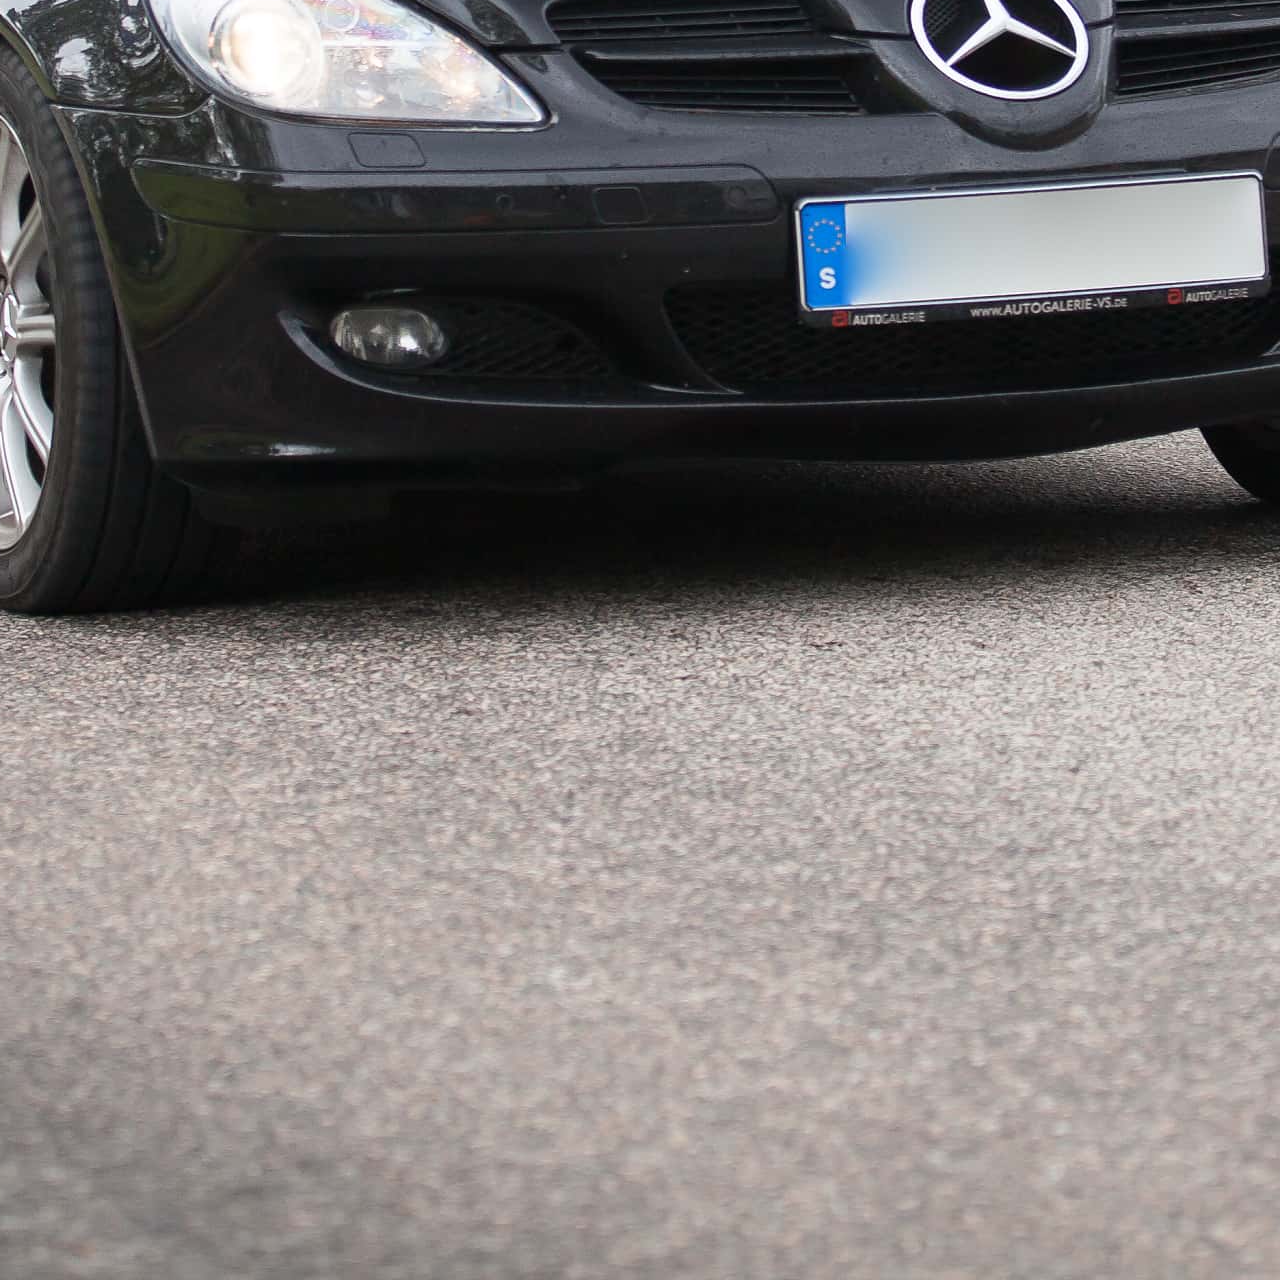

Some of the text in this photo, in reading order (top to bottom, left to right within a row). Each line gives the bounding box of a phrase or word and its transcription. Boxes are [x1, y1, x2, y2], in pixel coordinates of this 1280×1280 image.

[819, 267, 837, 290] S
[1185, 287, 1249, 303] AUTOGALERIE
[852, 312, 926, 326] AUTOGALERIE
